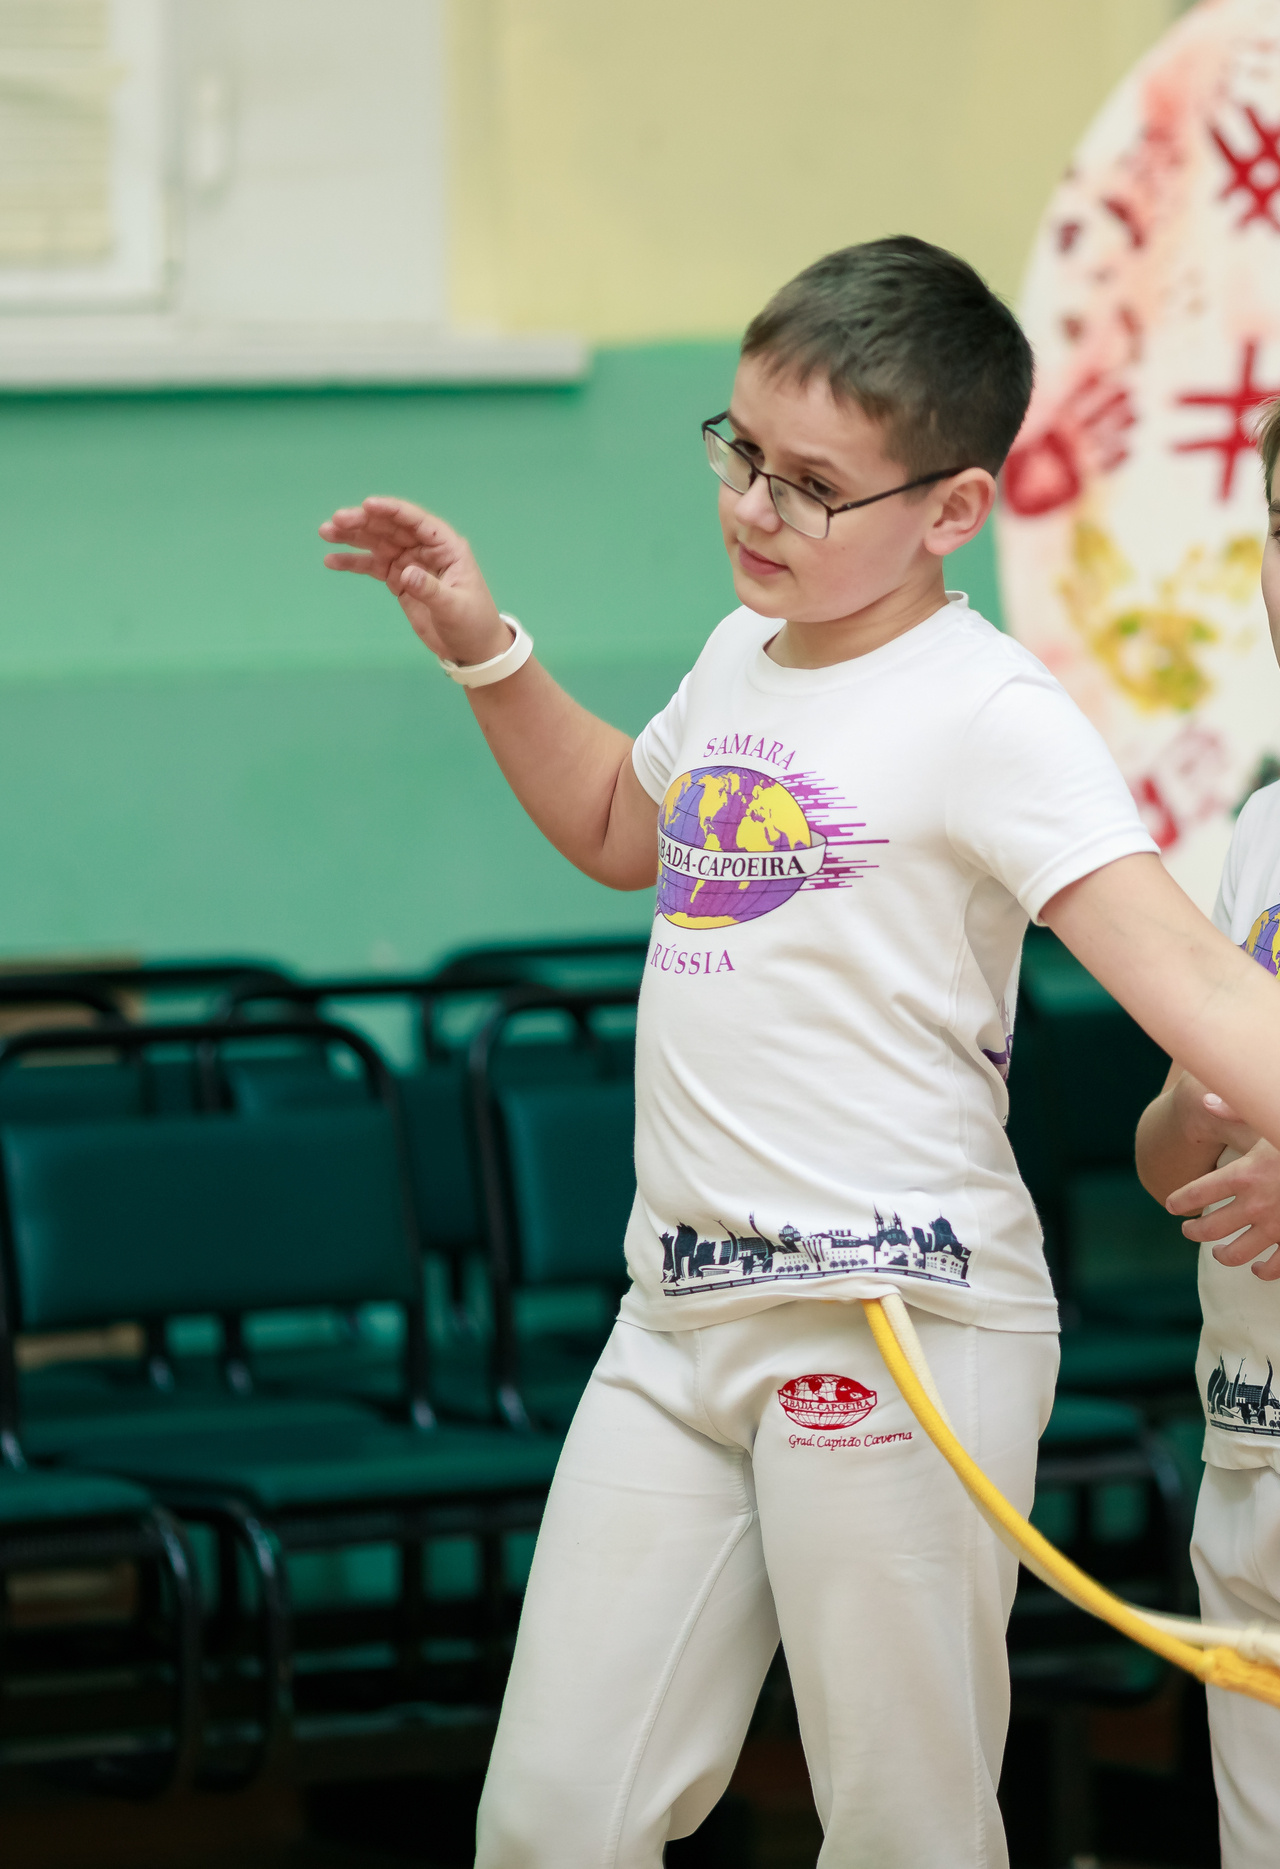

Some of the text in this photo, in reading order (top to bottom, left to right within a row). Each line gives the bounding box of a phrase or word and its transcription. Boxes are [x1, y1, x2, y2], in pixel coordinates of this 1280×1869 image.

[703, 733, 797, 771] SAMARA
[659, 836, 807, 878] BADÁ-CAPOEIRA
[650, 942, 735, 976] RÚSSIA
[863, 1431, 912, 1448] Caverna
